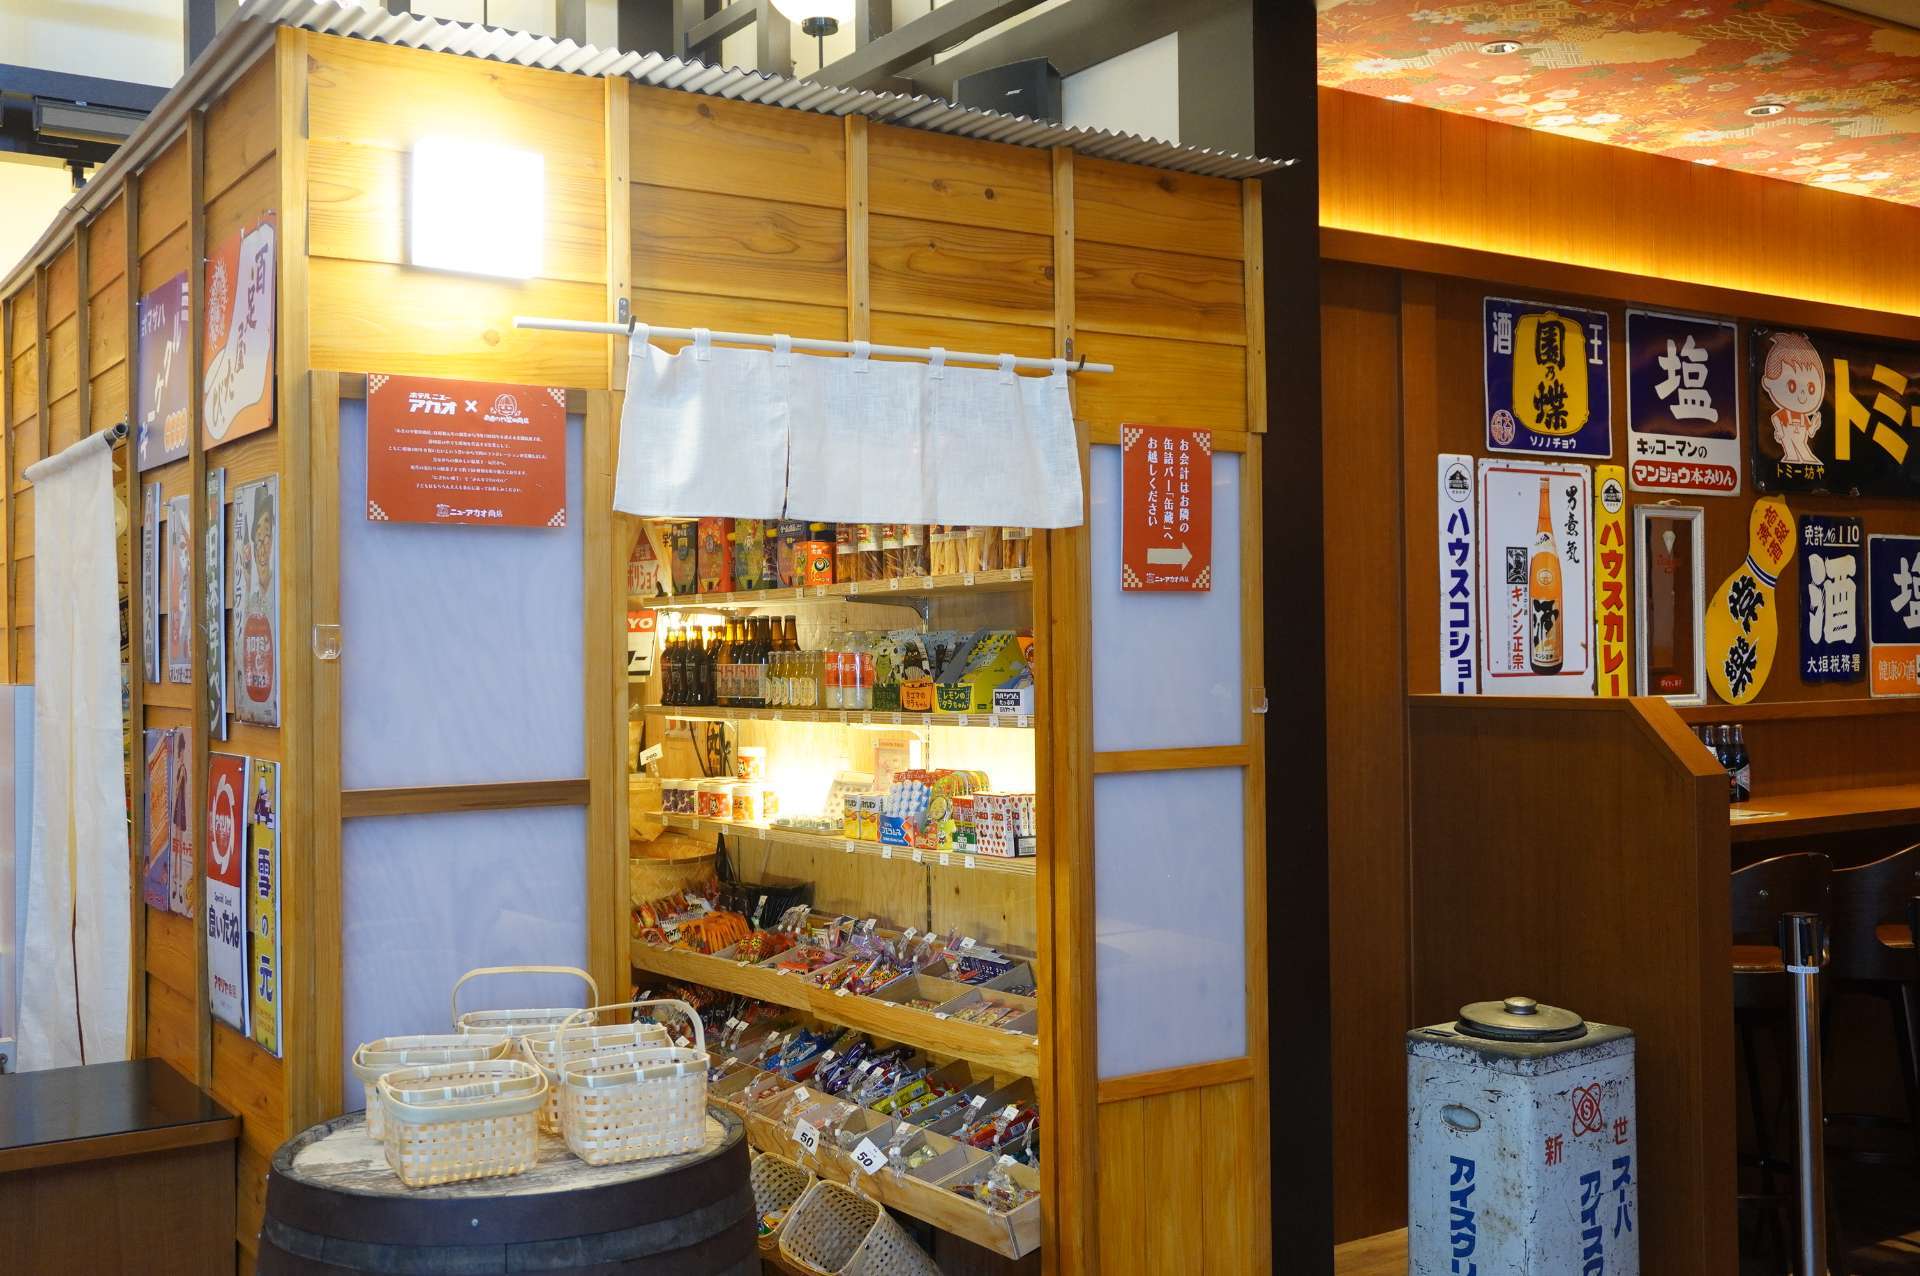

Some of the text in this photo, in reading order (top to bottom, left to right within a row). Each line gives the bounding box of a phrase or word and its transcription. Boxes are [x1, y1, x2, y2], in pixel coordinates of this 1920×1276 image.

[1493, 311, 1512, 355] 酒
[1654, 334, 1719, 424] 塩
[408, 398, 458, 415] アカオ
[1833, 358, 1920, 465] トミ
[1530, 436, 1577, 449] ソノノチョウ
[1636, 437, 1708, 459] キッコーマンの
[1147, 437, 1158, 527] お越しください
[1163, 437, 1174, 540] 缶詰バー「缶蔵」へ
[1179, 438, 1190, 533] お会計はお隣の
[1634, 464, 1735, 487] マンジョウ本みりん
[1776, 463, 1825, 480] トミー坊や
[234, 496, 243, 541] 元気
[449, 508, 503, 518] ニューアカオ商店
[1600, 520, 1624, 696] ハウスカレー
[1808, 553, 1857, 645] 酒
[1511, 586, 1524, 670] キンシ正宗
[1807, 654, 1860, 673] 大垣税務署
[941, 700, 967, 709] タラちゃん
[943, 691, 965, 700] レモンの
[995, 692, 1020, 700] カルシウム
[209, 904, 240, 949] 良いたね
[258, 848, 274, 1004] 雪の元
[800, 1131, 814, 1148] 50
[856, 1151, 874, 1167] 50
[1544, 1116, 1628, 1166] 新 世
